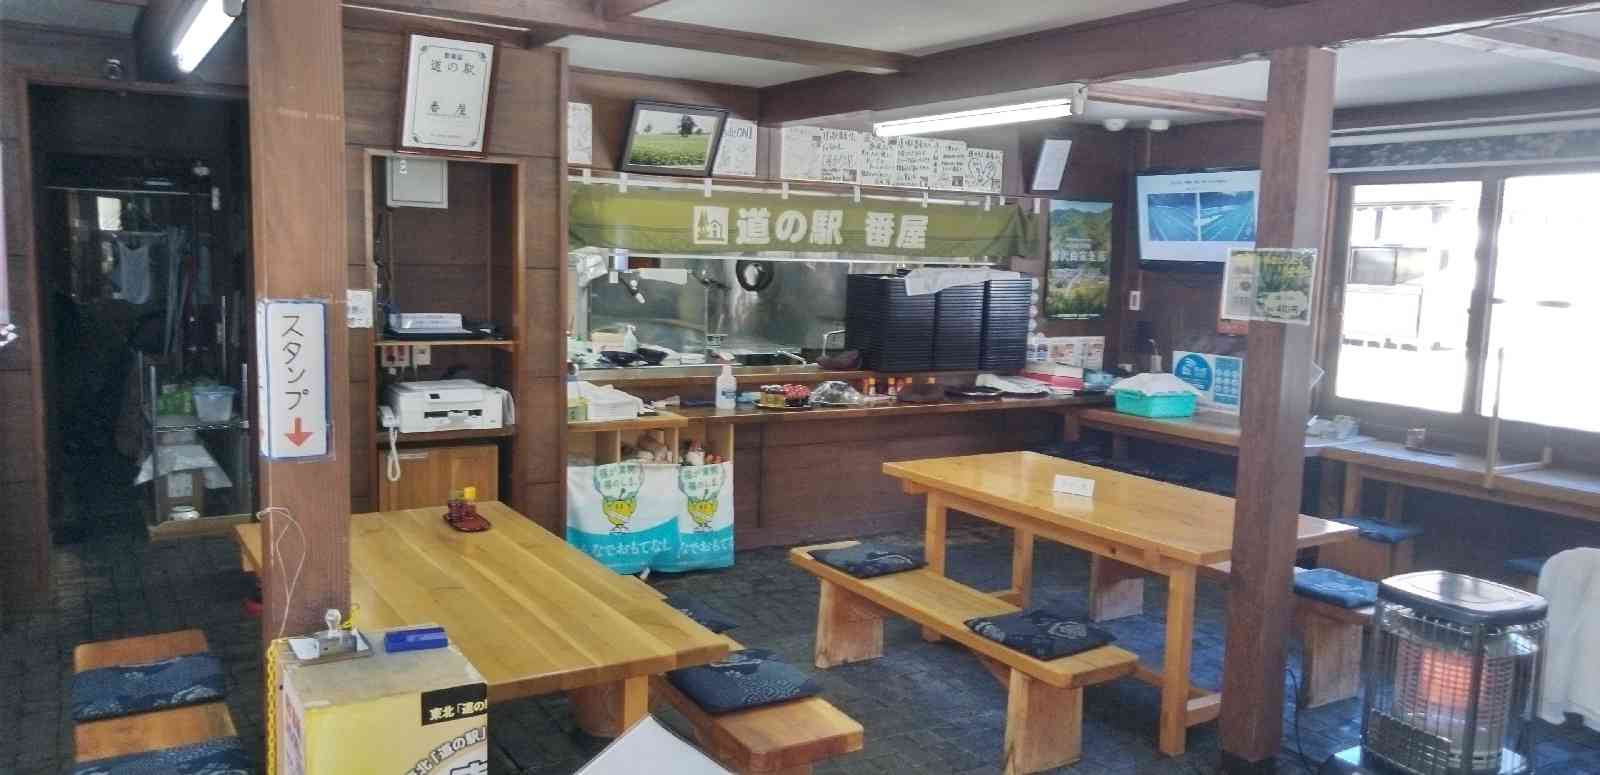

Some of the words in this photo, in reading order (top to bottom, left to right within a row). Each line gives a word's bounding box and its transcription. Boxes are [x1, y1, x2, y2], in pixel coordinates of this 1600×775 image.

[735, 206, 843, 246] 道の駅
[865, 210, 929, 249] 番屋
[281, 315, 310, 410] スタンプ
[429, 699, 487, 721] 東北「道の
